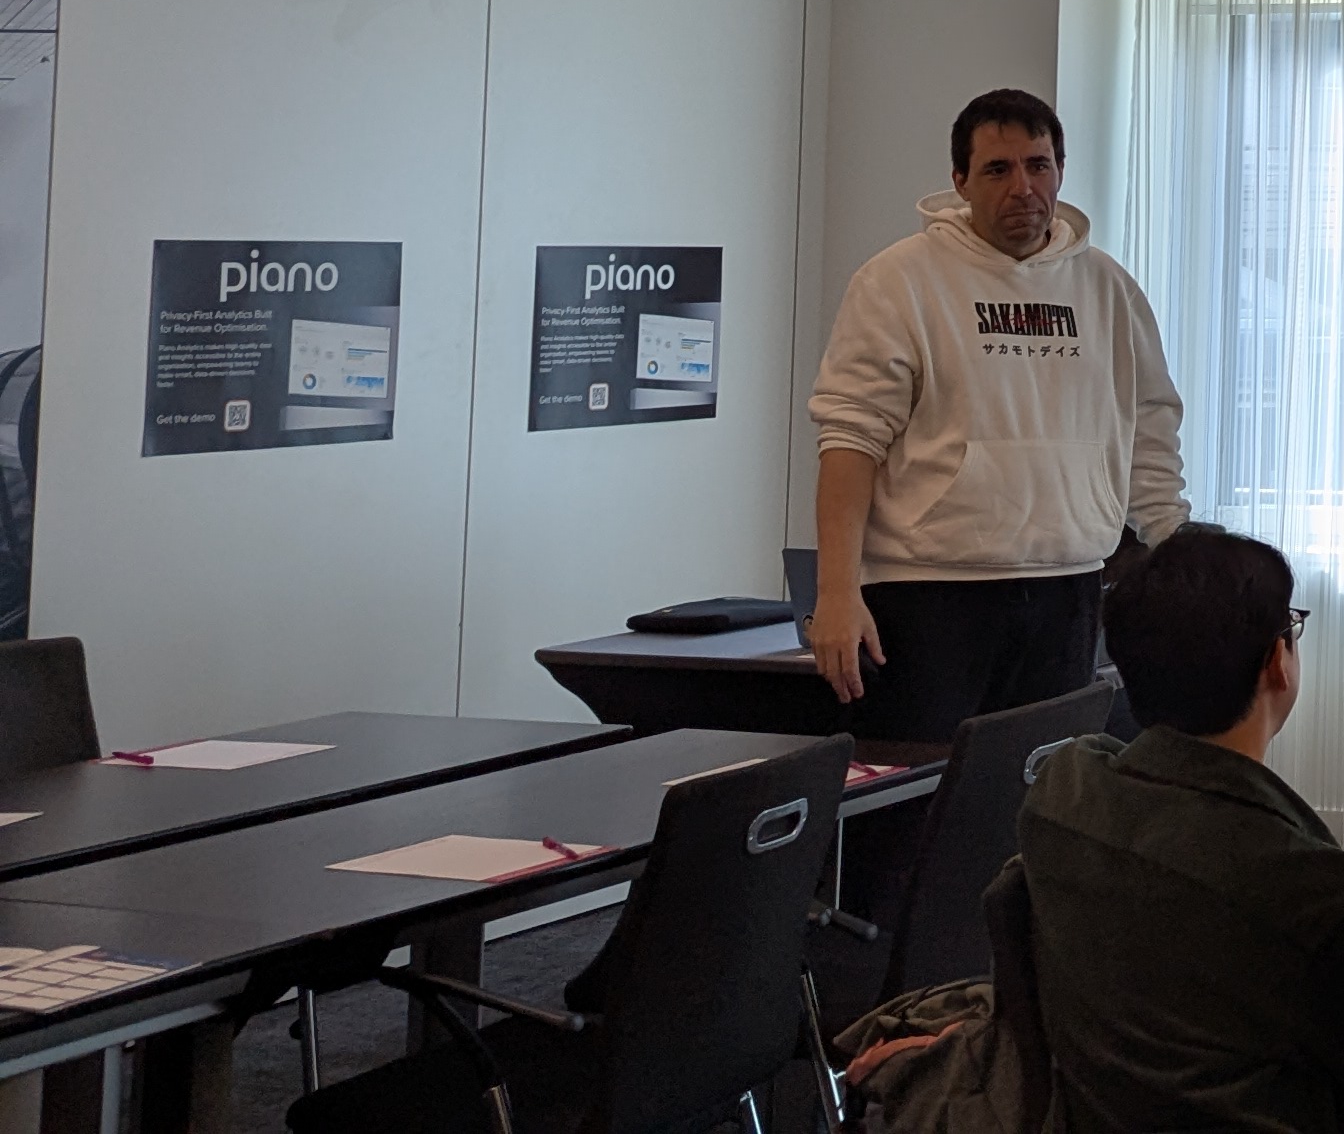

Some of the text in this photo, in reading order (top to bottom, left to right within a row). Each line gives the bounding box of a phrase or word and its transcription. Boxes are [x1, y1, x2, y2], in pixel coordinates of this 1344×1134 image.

[219, 249, 339, 302] piano
[584, 253, 675, 299] piano
[214, 310, 253, 321] Analytics
[974, 302, 1078, 338] SAKAMOTO
[982, 343, 1080, 357] サカモトデイズ
[156, 415, 173, 425] Get
[190, 413, 216, 423] demo
